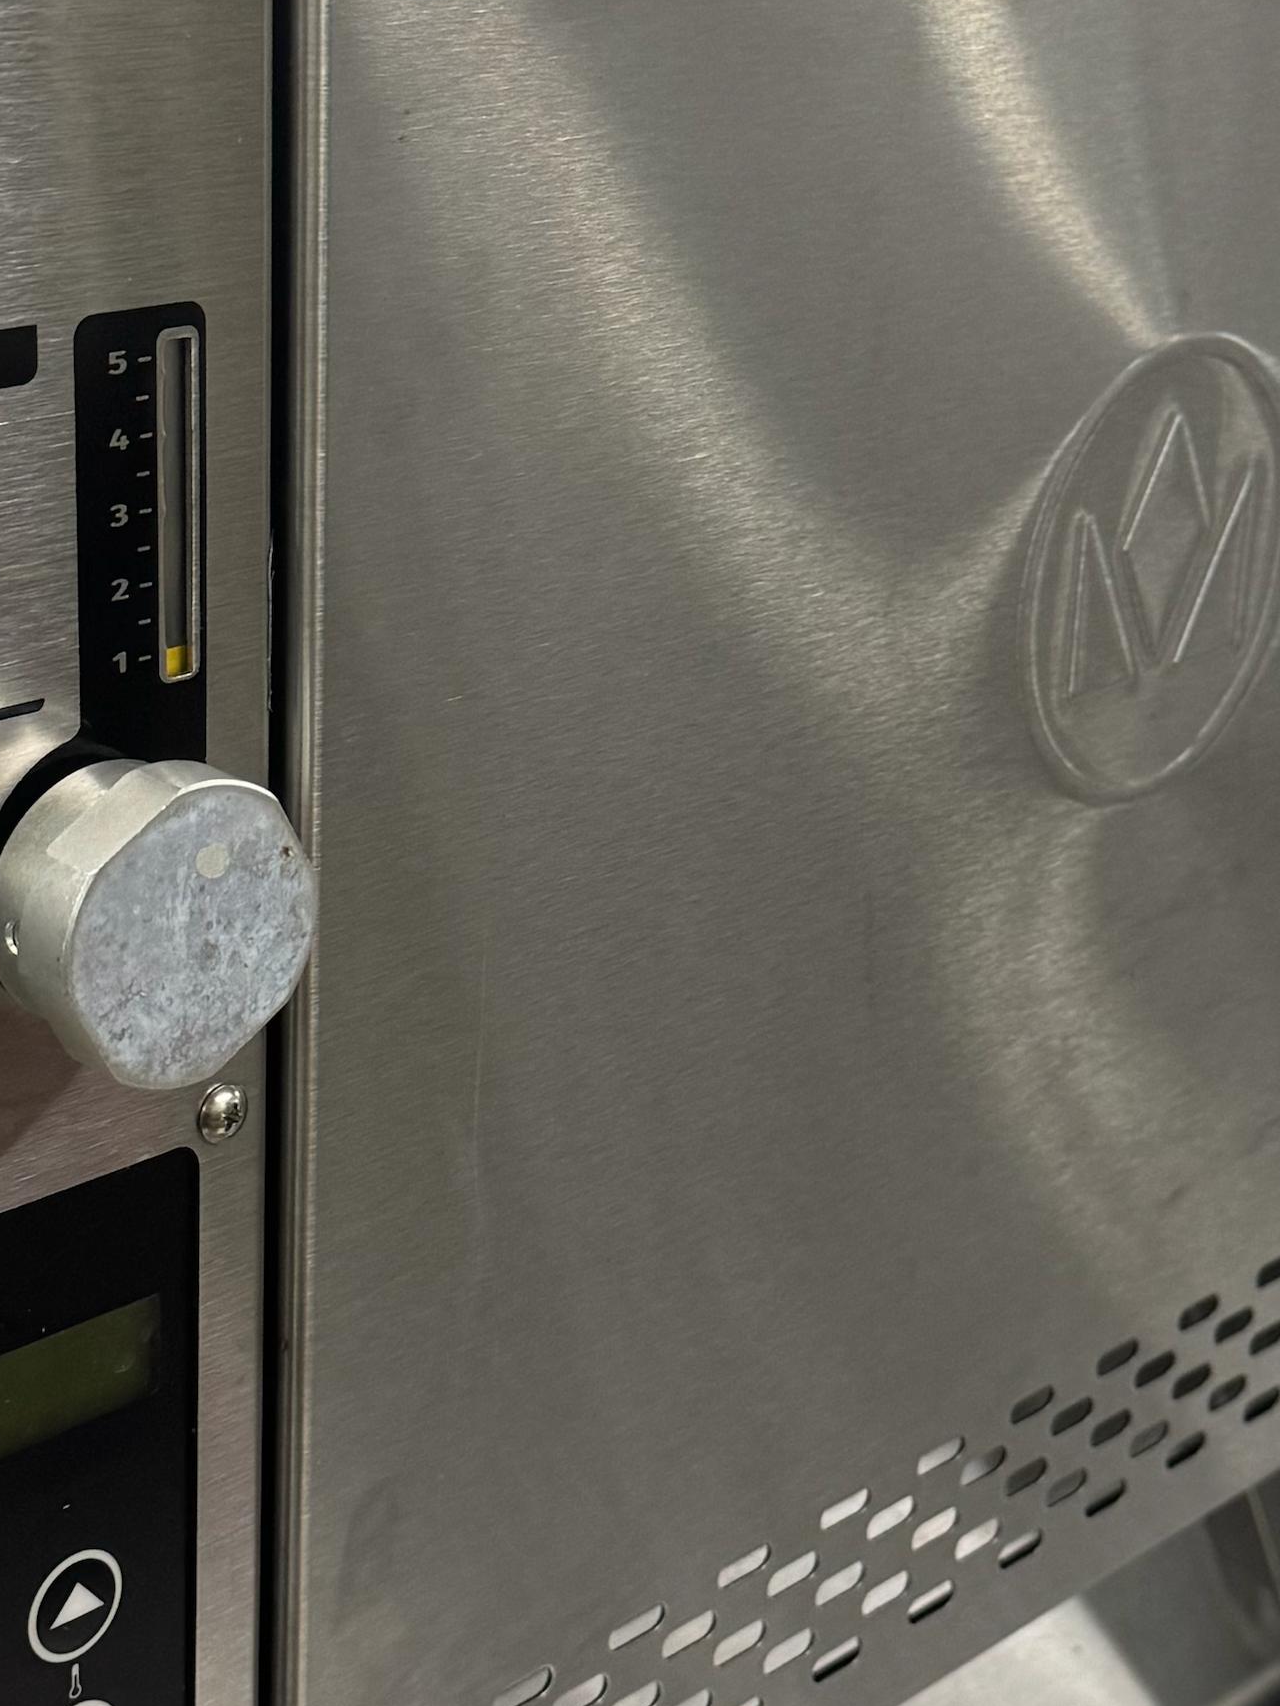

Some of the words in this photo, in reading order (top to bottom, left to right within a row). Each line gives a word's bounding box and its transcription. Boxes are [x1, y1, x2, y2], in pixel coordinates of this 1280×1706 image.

[106, 350, 128, 375] 5
[108, 428, 130, 451] 4
[109, 503, 129, 528] 3
[110, 578, 129, 602] 2
[112, 650, 127, 674] 1
